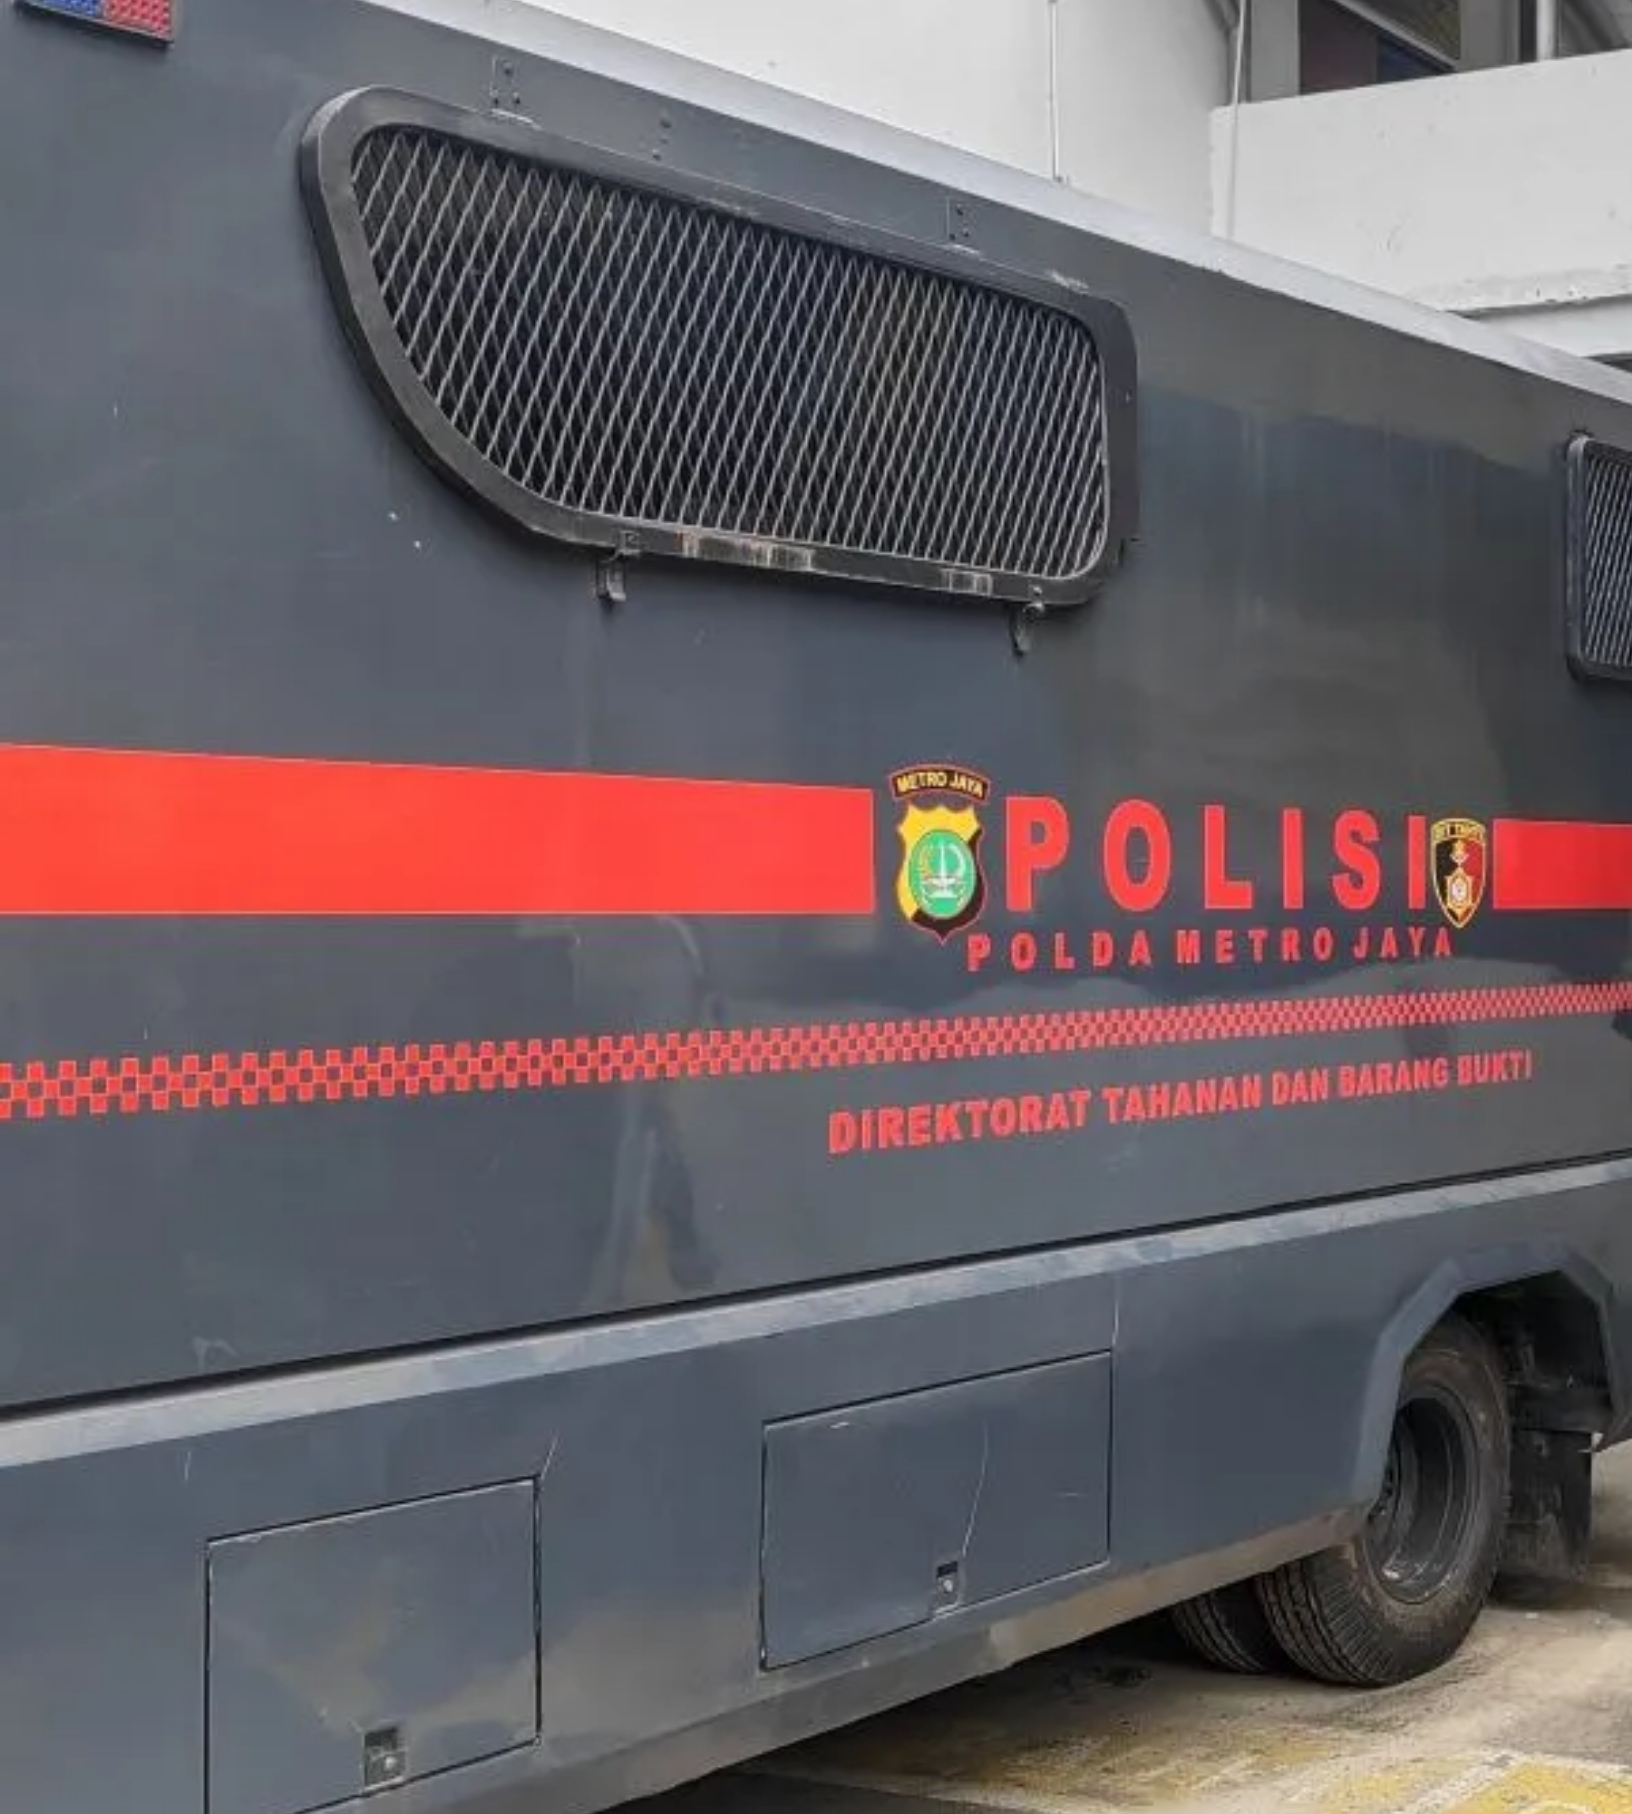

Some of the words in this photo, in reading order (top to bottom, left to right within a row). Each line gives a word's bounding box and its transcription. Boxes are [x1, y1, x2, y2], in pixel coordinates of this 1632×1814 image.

[896, 771, 948, 793] METRO
[949, 772, 983, 799] JAYA
[1004, 795, 1428, 913] POLISI
[966, 929, 1154, 972] POLDA
[1175, 926, 1336, 966] METRO
[1353, 925, 1453, 960] JAYA
[827, 1088, 1091, 1155] DIREKTORAT
[1101, 1074, 1263, 1124] TAHANAN
[1271, 1067, 1330, 1106] DAN
[1337, 1056, 1449, 1099] BARANG
[1456, 1048, 1533, 1087] BUKTI
